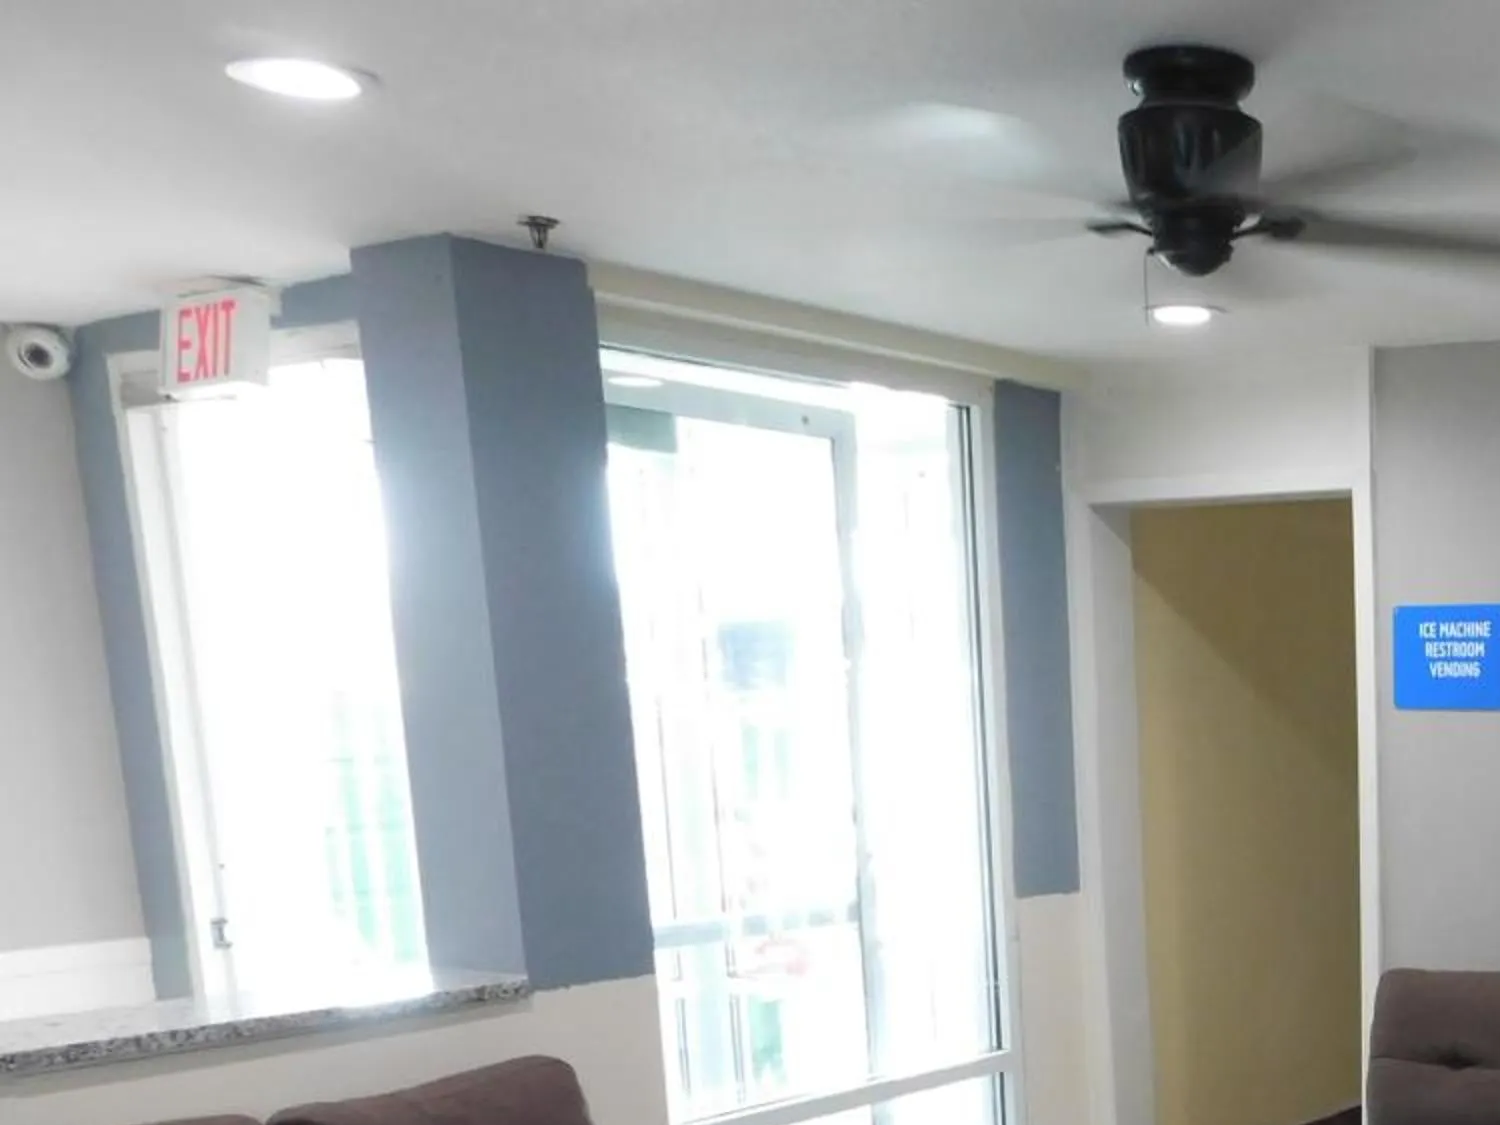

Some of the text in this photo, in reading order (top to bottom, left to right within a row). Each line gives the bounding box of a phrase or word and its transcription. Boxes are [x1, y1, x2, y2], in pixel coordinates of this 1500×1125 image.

[177, 299, 236, 383] EXIT
[1419, 620, 1492, 638] ICE MACHINE
[1425, 641, 1485, 657] RESTROOM
[1429, 660, 1481, 678] VENDING
